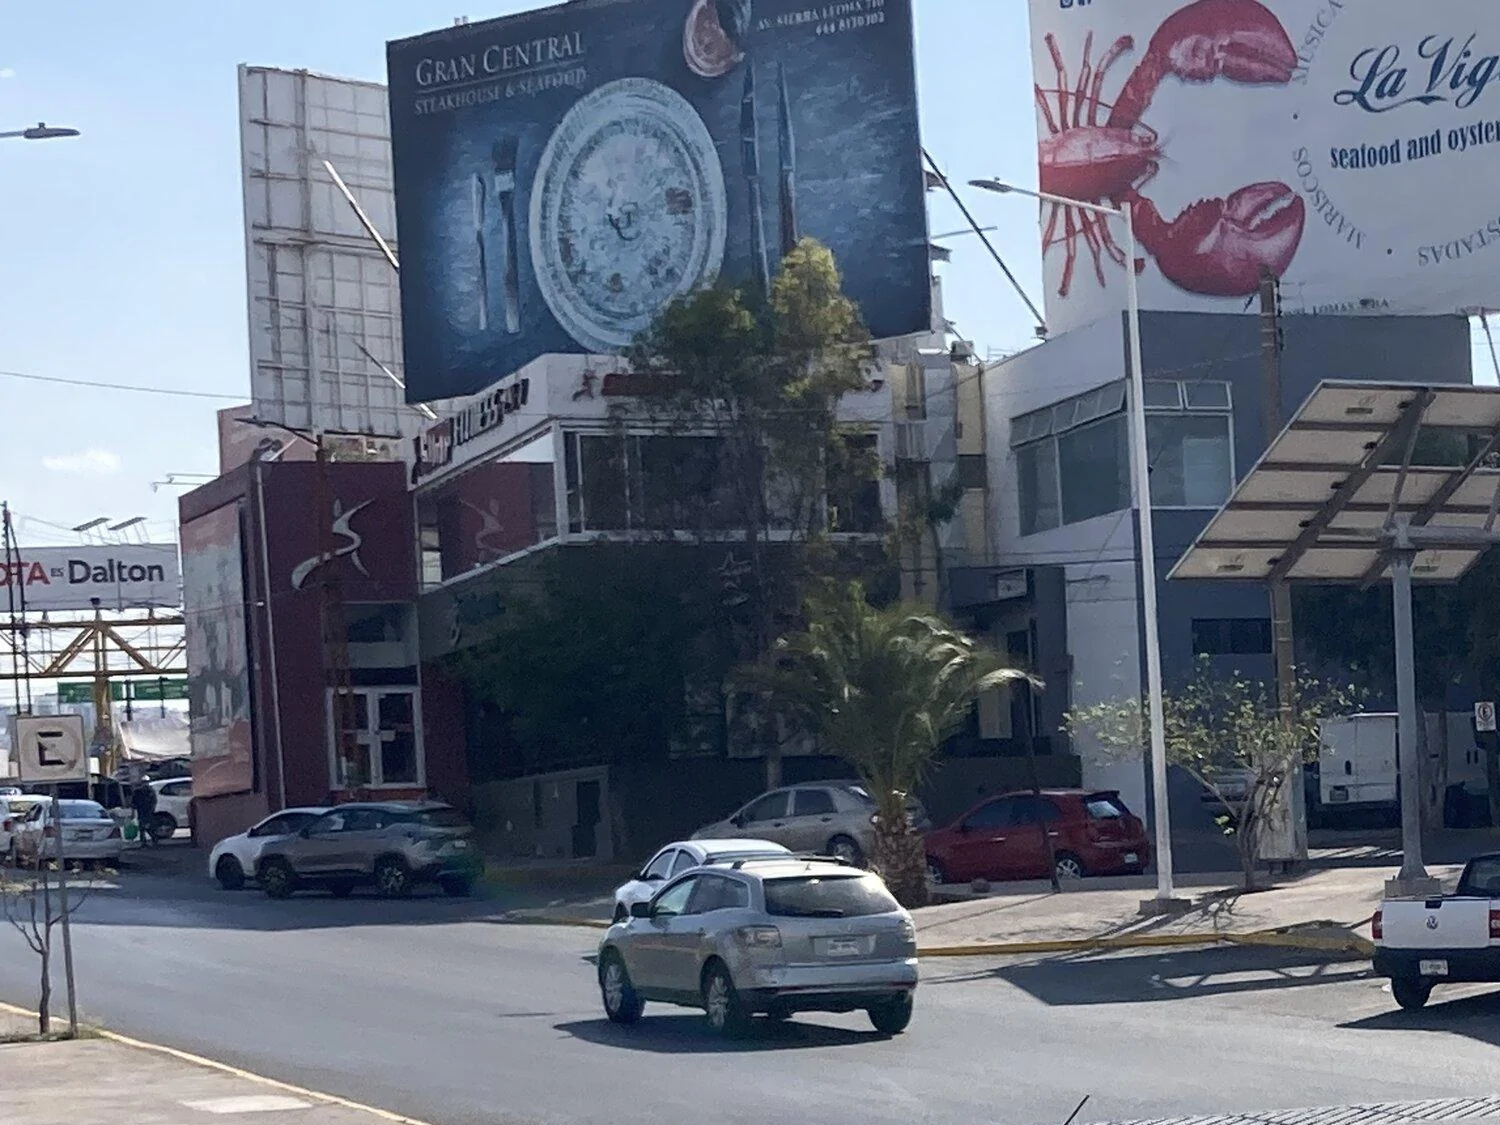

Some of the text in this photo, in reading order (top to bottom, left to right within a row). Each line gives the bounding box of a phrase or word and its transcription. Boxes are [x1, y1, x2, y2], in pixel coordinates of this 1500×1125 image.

[415, 31, 586, 86] GRAN CENTRAL
[1333, 44, 1411, 113] La
[413, 67, 588, 115] STEAKHOUSE & SEAFOOD
[1330, 139, 1401, 169] seafood
[1406, 128, 1442, 161] and
[1292, 146, 1368, 249] MARISCOS
[68, 558, 165, 585] Dalton
